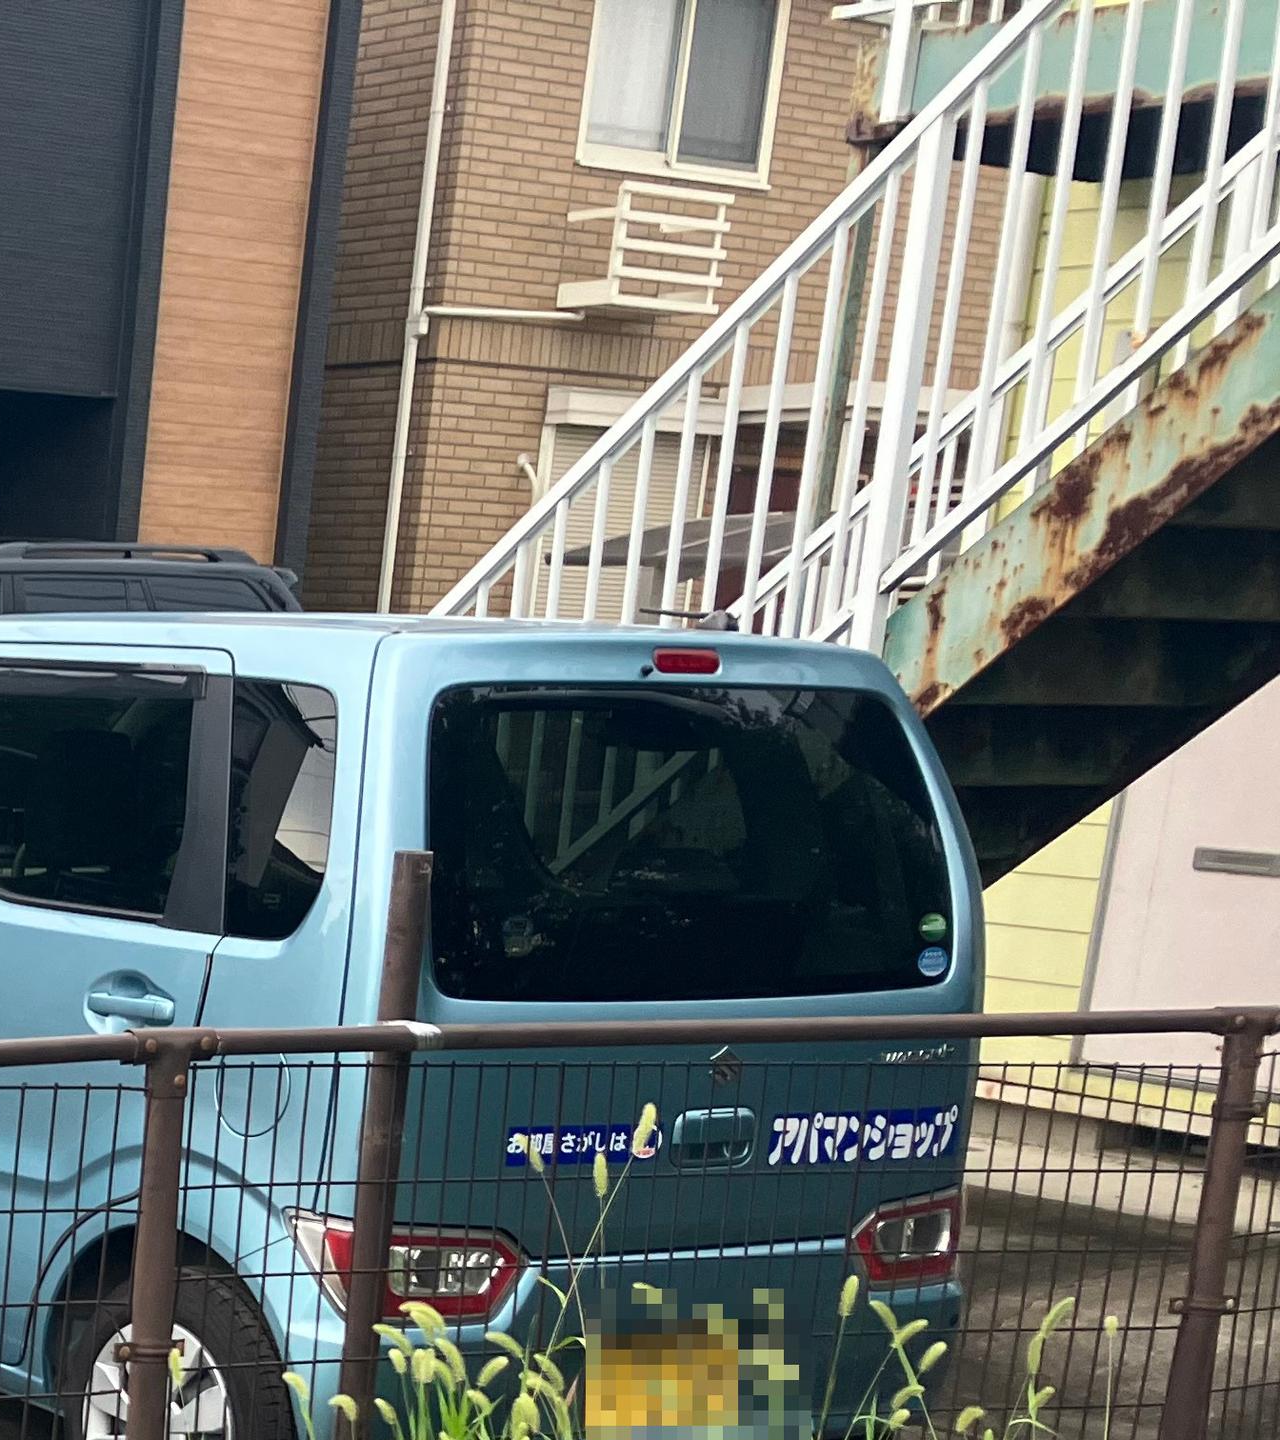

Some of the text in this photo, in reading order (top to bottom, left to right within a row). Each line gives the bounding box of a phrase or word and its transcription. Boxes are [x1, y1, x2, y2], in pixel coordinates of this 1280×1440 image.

[767, 1104, 959, 1166] アパマンショップ
